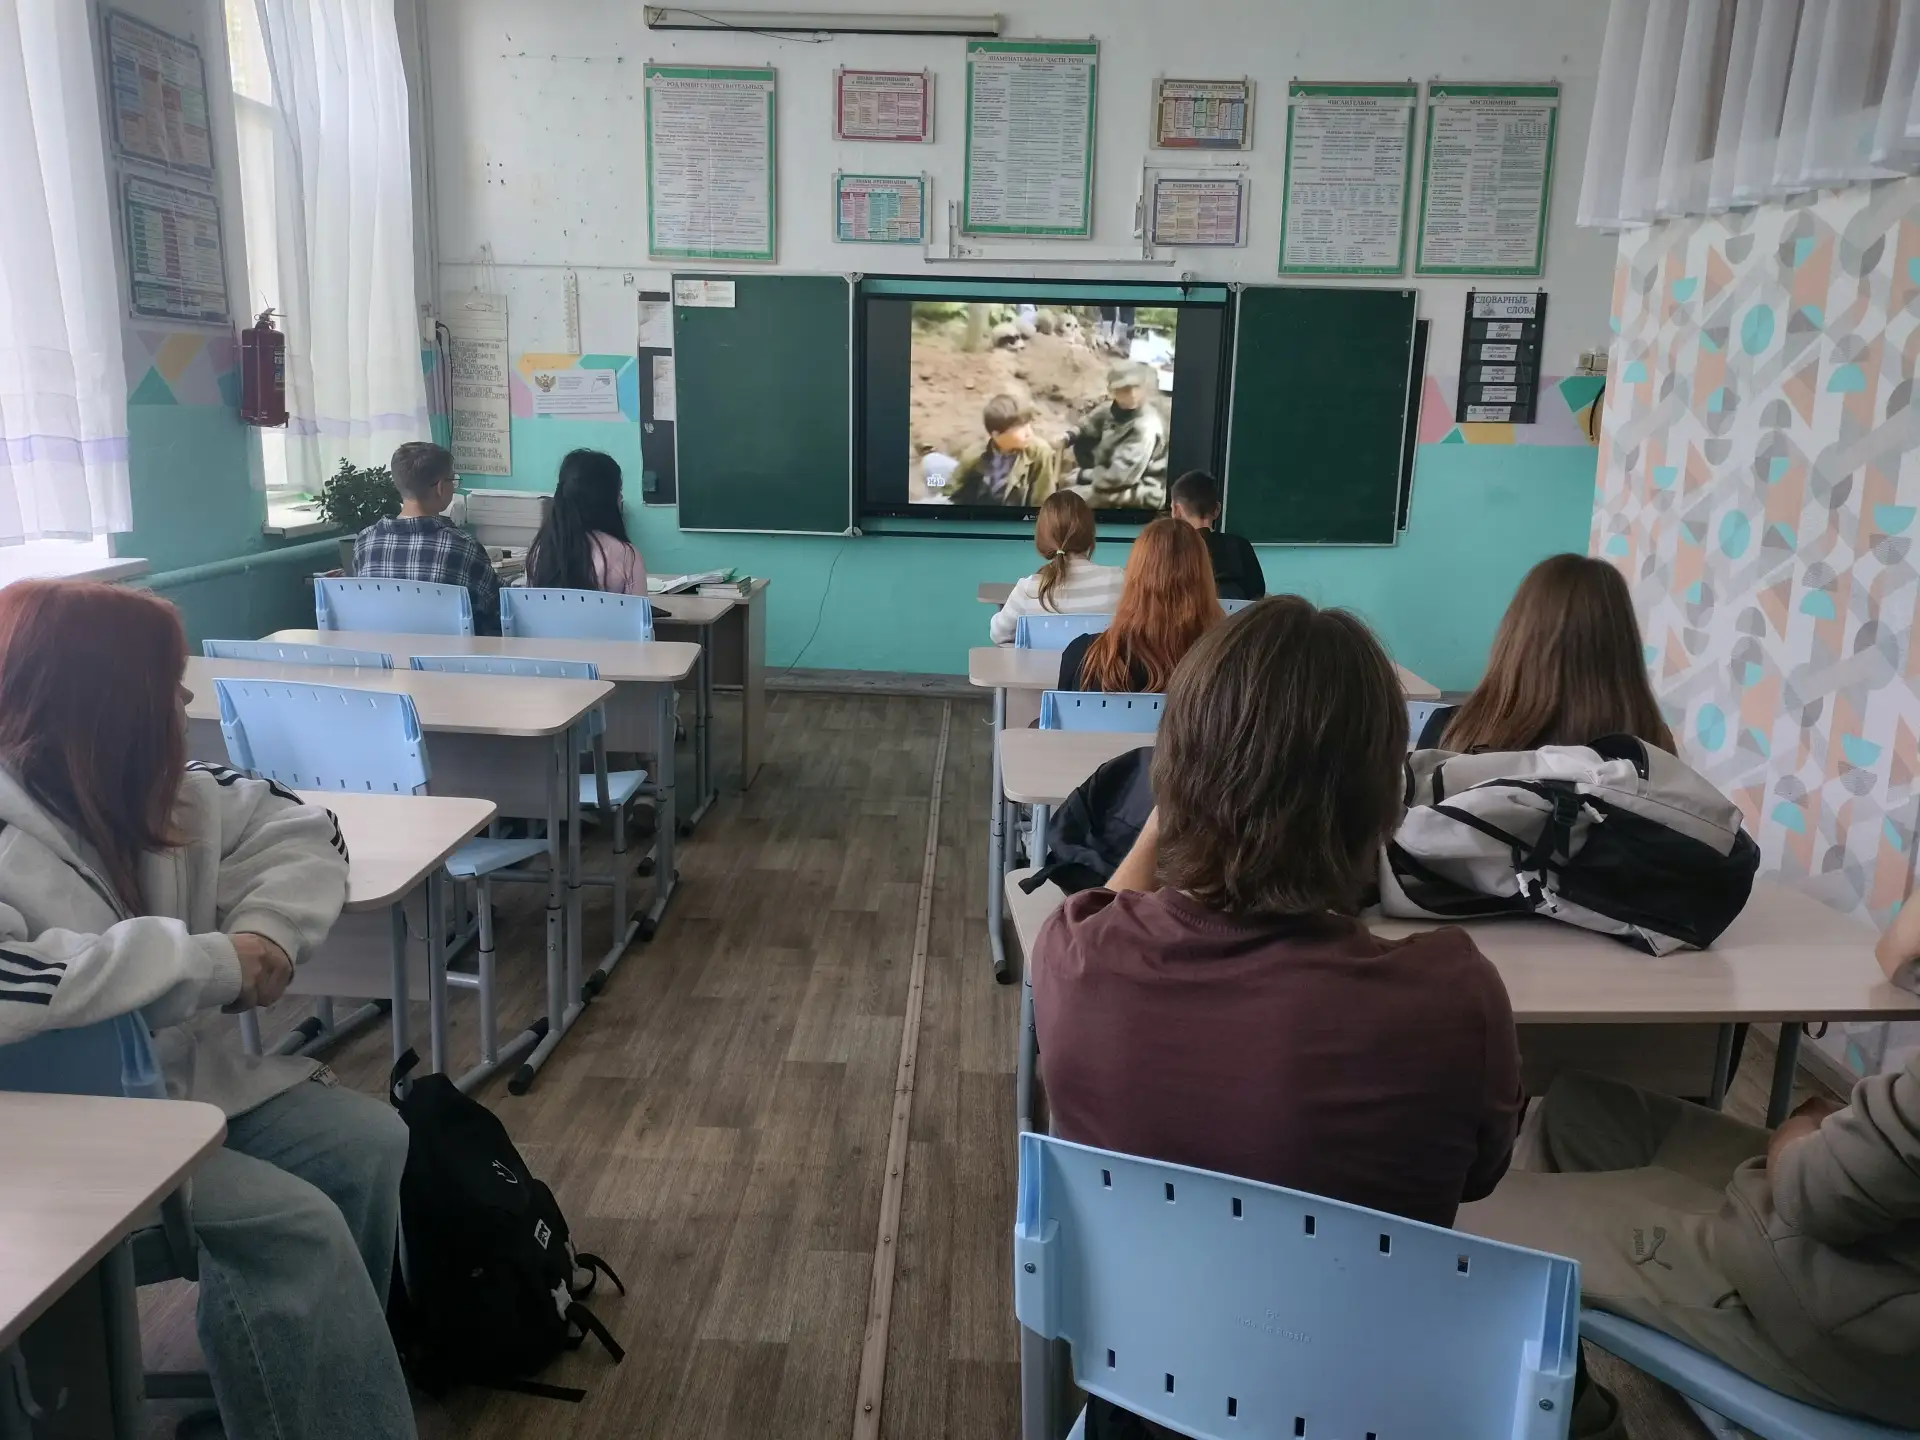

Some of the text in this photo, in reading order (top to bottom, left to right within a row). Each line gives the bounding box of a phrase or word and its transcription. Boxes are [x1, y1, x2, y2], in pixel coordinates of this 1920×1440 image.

[700, 82, 764, 90] СУЩЕСТВИТЕЛЬНЫХ
[1475, 295, 1528, 304] СЛОВАРНЫЕ
[1506, 306, 1536, 314] СЛОВА
